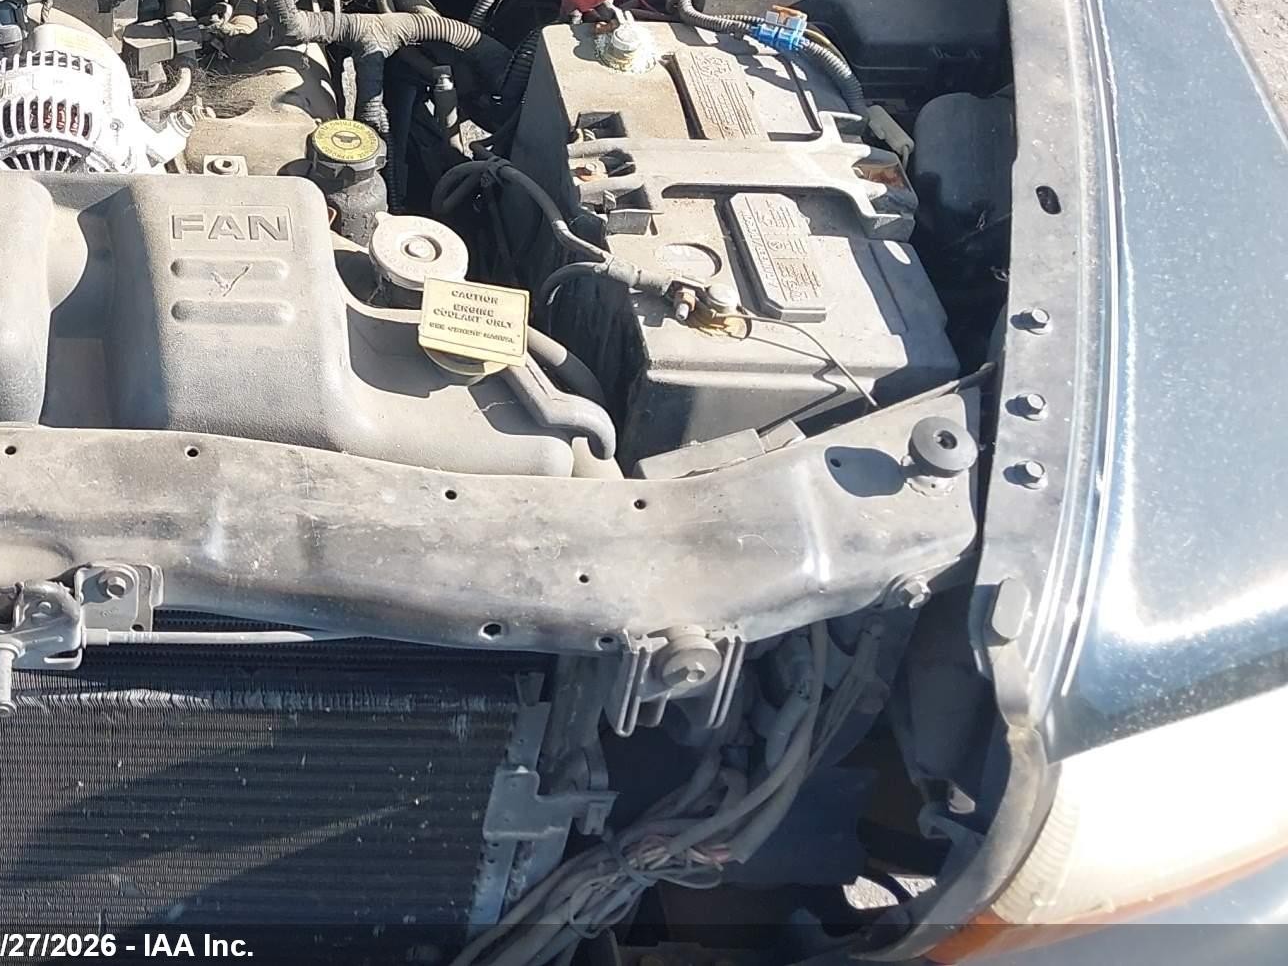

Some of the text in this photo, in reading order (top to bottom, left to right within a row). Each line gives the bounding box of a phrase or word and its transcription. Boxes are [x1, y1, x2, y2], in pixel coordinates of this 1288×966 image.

[169, 213, 291, 242] FAN
[451, 289, 499, 305] CAUTION
[432, 307, 514, 330] COOLANT ONLY
[453, 303, 495, 318] ENGINE
